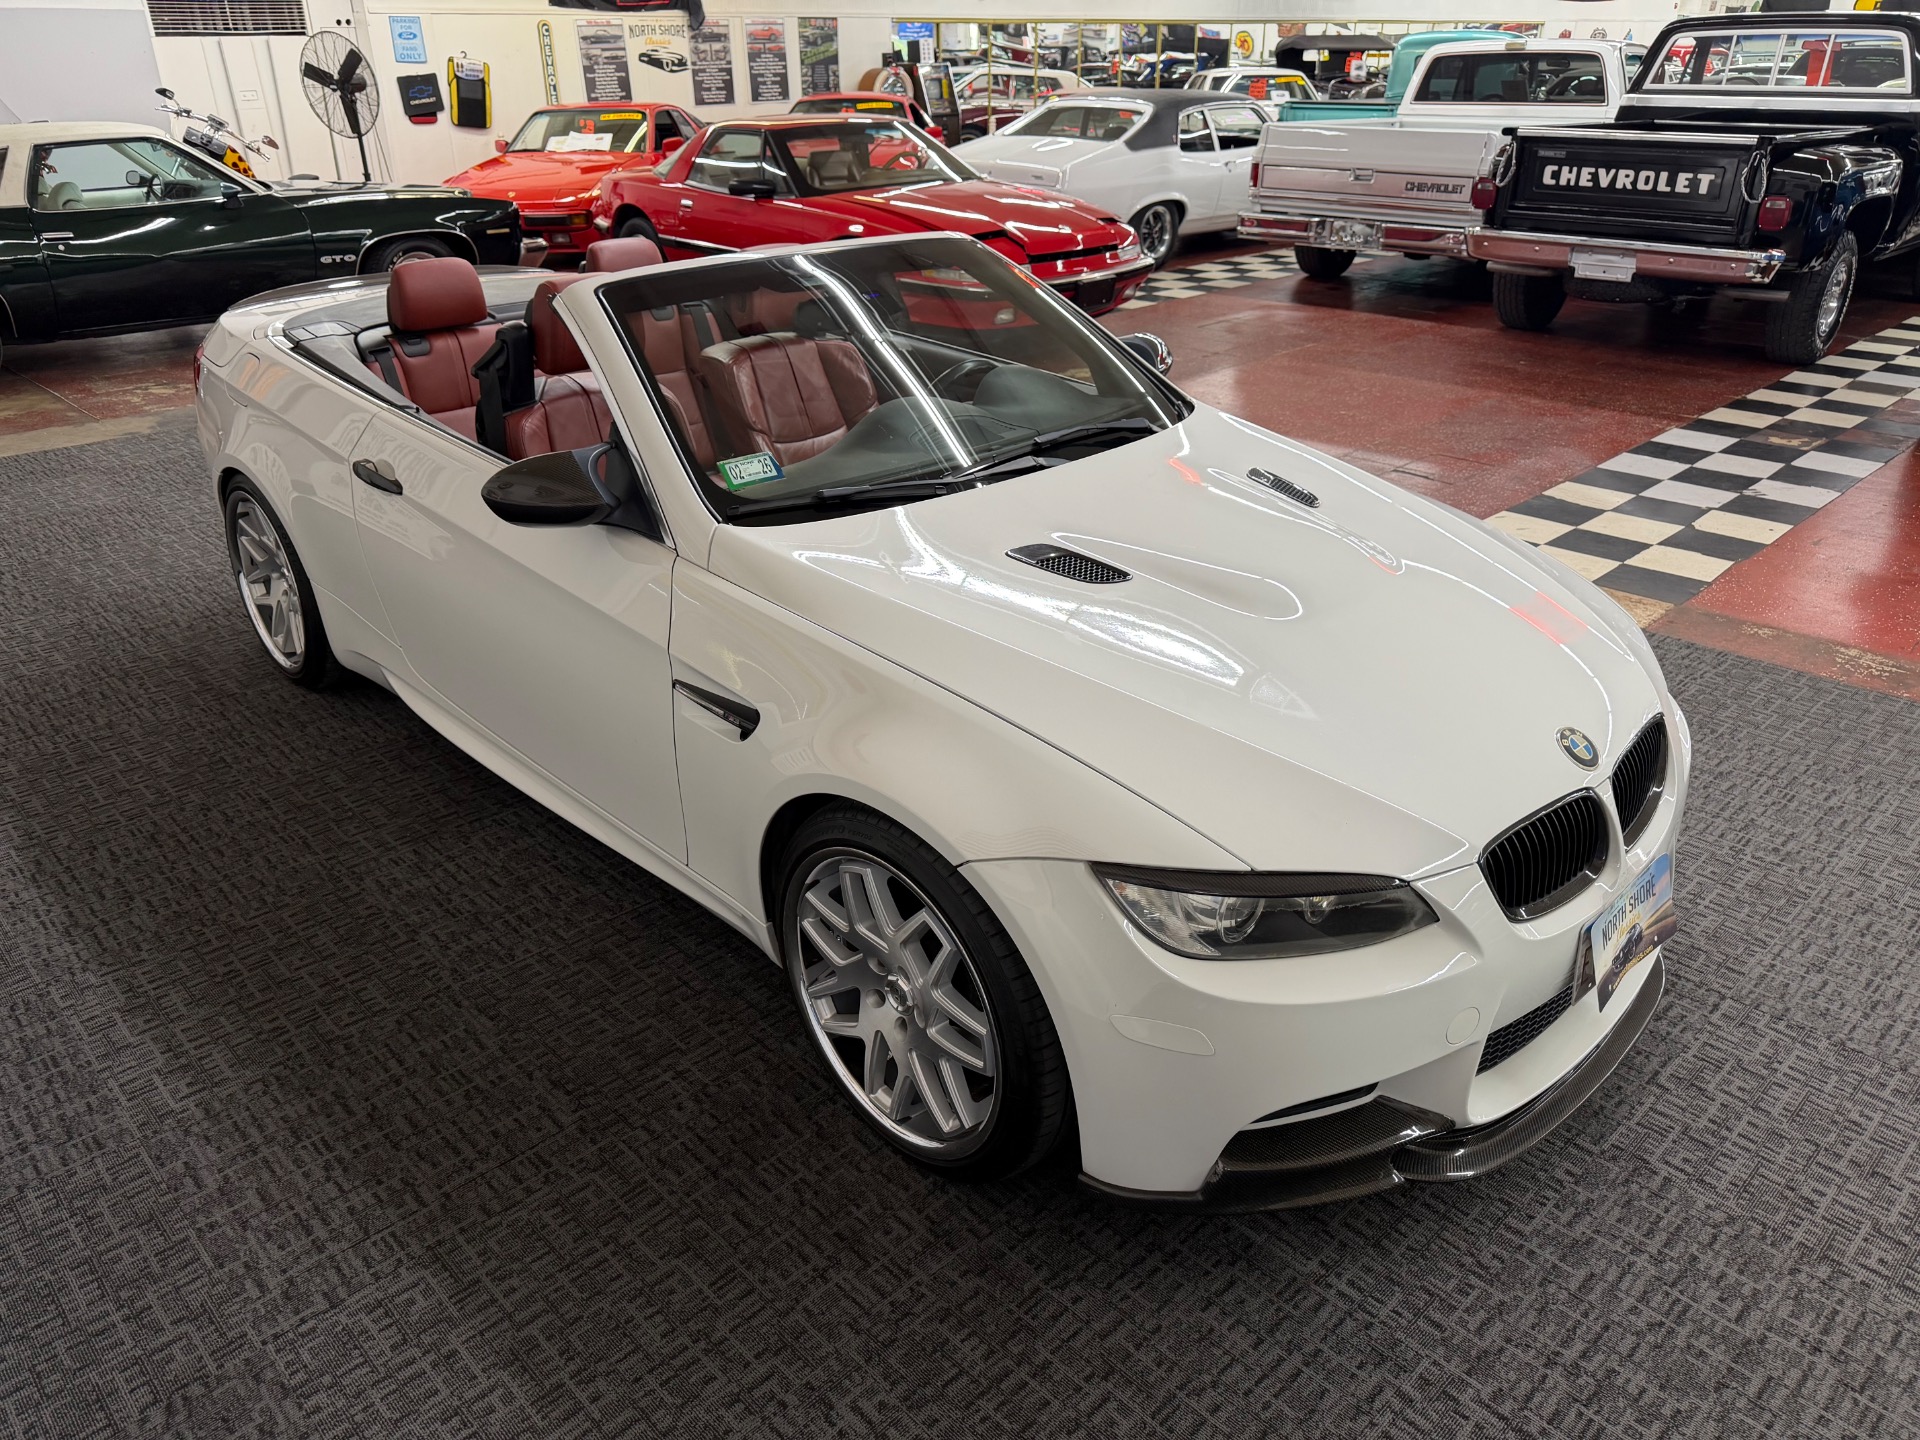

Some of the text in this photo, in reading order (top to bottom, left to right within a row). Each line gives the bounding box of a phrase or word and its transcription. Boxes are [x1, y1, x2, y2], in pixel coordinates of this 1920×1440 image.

[628, 24, 686, 39] NORTH SHORE
[645, 36, 672, 46] Classics
[400, 52, 421, 60] ONLY
[542, 25, 558, 105] CHEVROLE
[410, 97, 436, 105] CHEVROLET
[1543, 165, 1716, 196] CHEVROLET
[1404, 181, 1466, 195] CHEVROLET
[320, 254, 357, 264] GTO
[729, 457, 773, 480] 02 26
[1602, 903, 1627, 951] NORTH
[1629, 873, 1657, 914] SHORE
